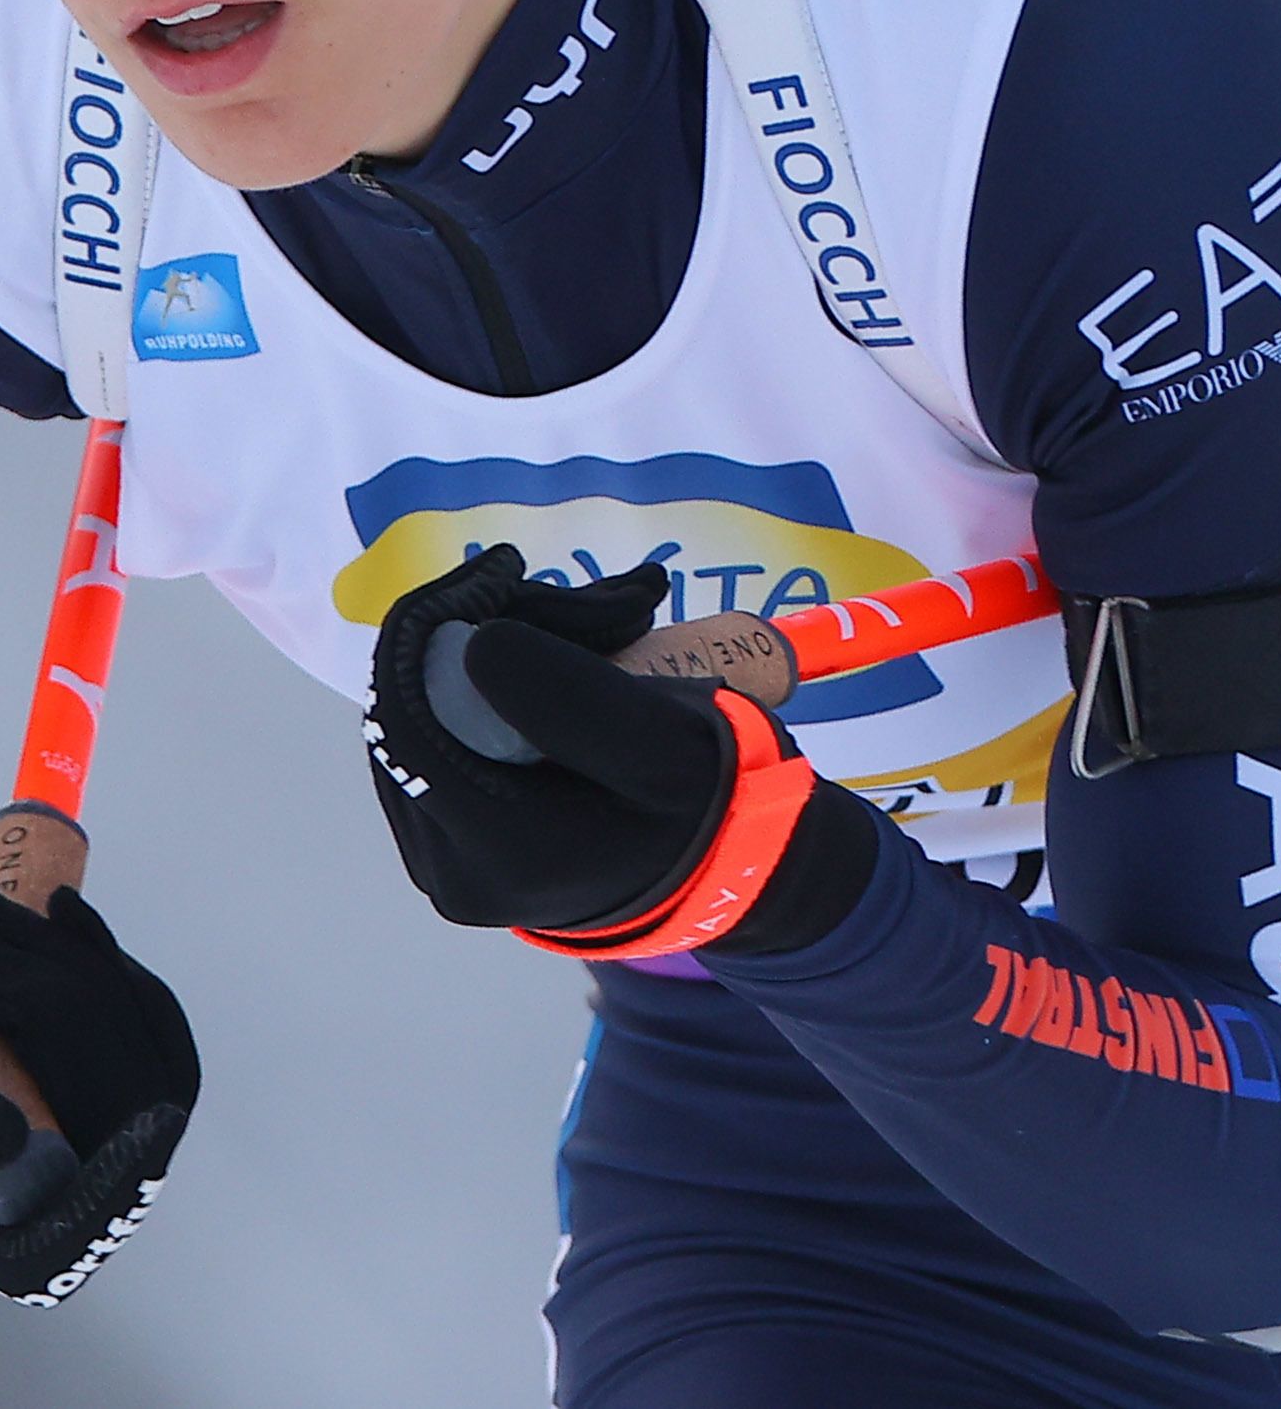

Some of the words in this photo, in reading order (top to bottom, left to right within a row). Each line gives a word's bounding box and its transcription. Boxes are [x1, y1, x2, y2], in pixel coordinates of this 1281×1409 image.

[62, 29, 125, 293] IOCCHI
[748, 74, 915, 348] FIOCCHI
[144, 333, 247, 351] RUHPOLDING
[1121, 348, 1266, 423] EMPORIO
[972, 944, 1231, 1093] FINSTRAL
